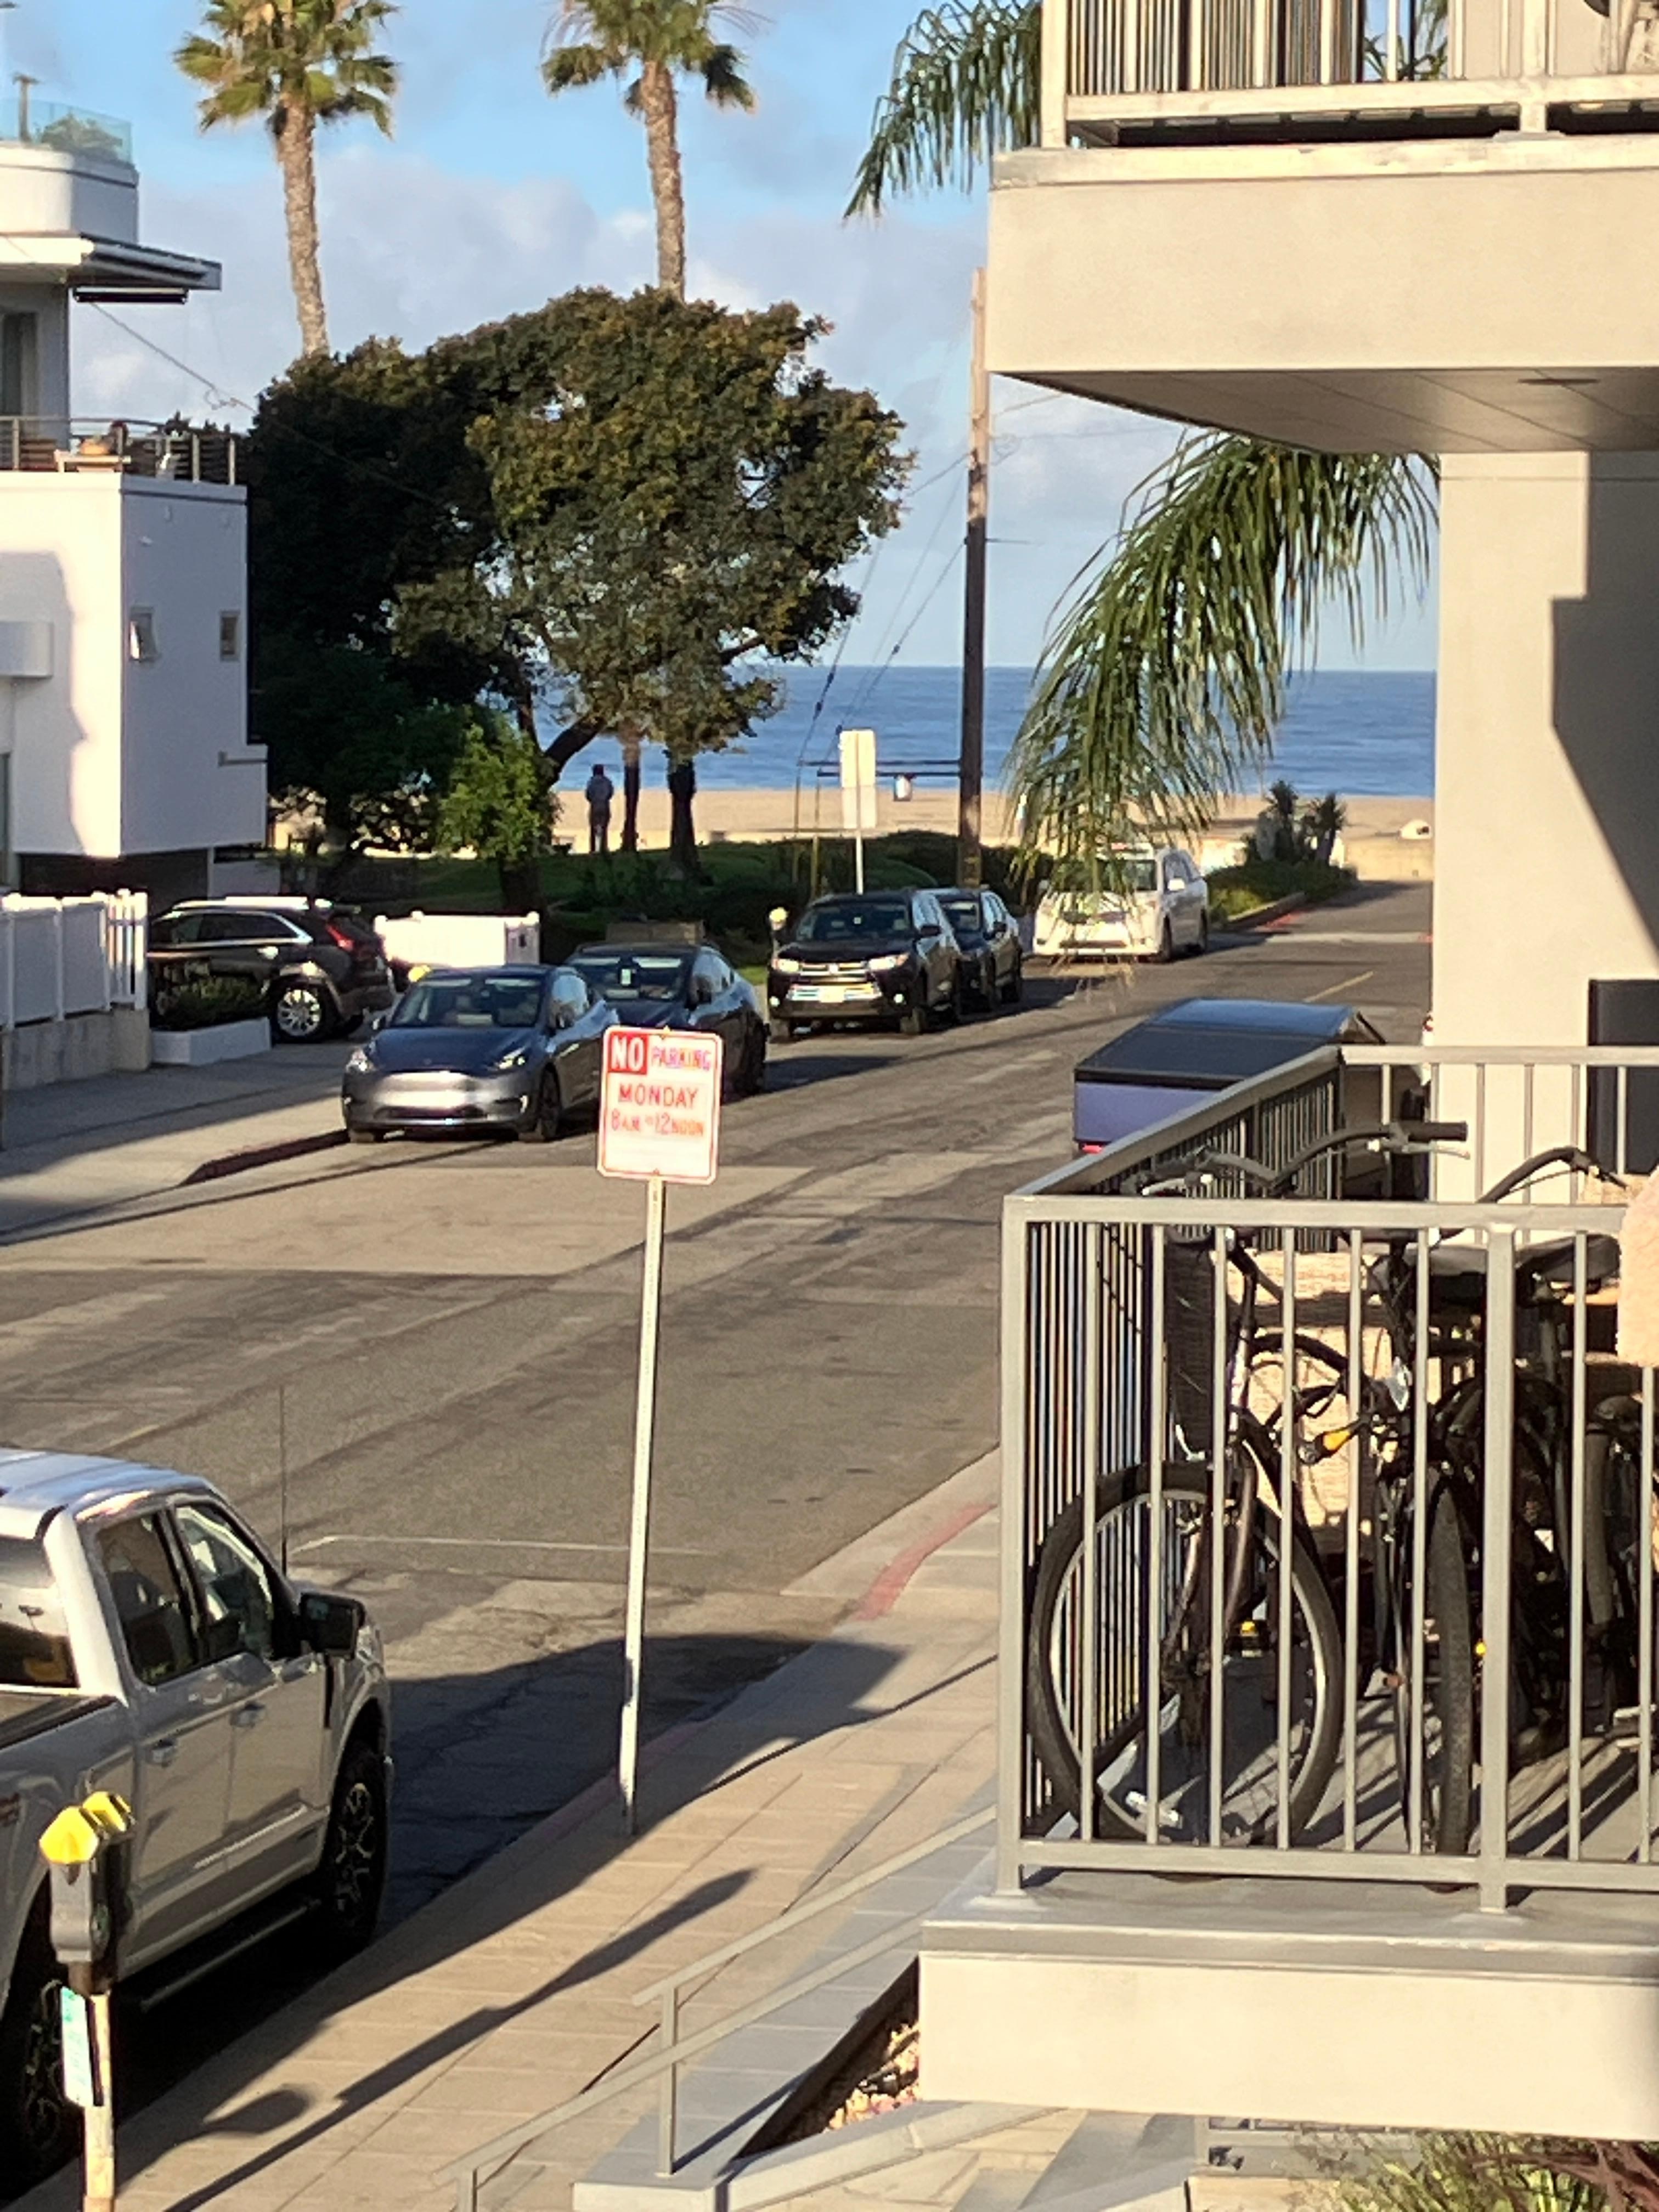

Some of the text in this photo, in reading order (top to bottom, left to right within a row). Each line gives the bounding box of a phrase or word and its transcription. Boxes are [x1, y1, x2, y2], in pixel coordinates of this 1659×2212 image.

[611, 1034, 712, 1071] NO PARKING
[618, 1083, 699, 1109] MONDAY
